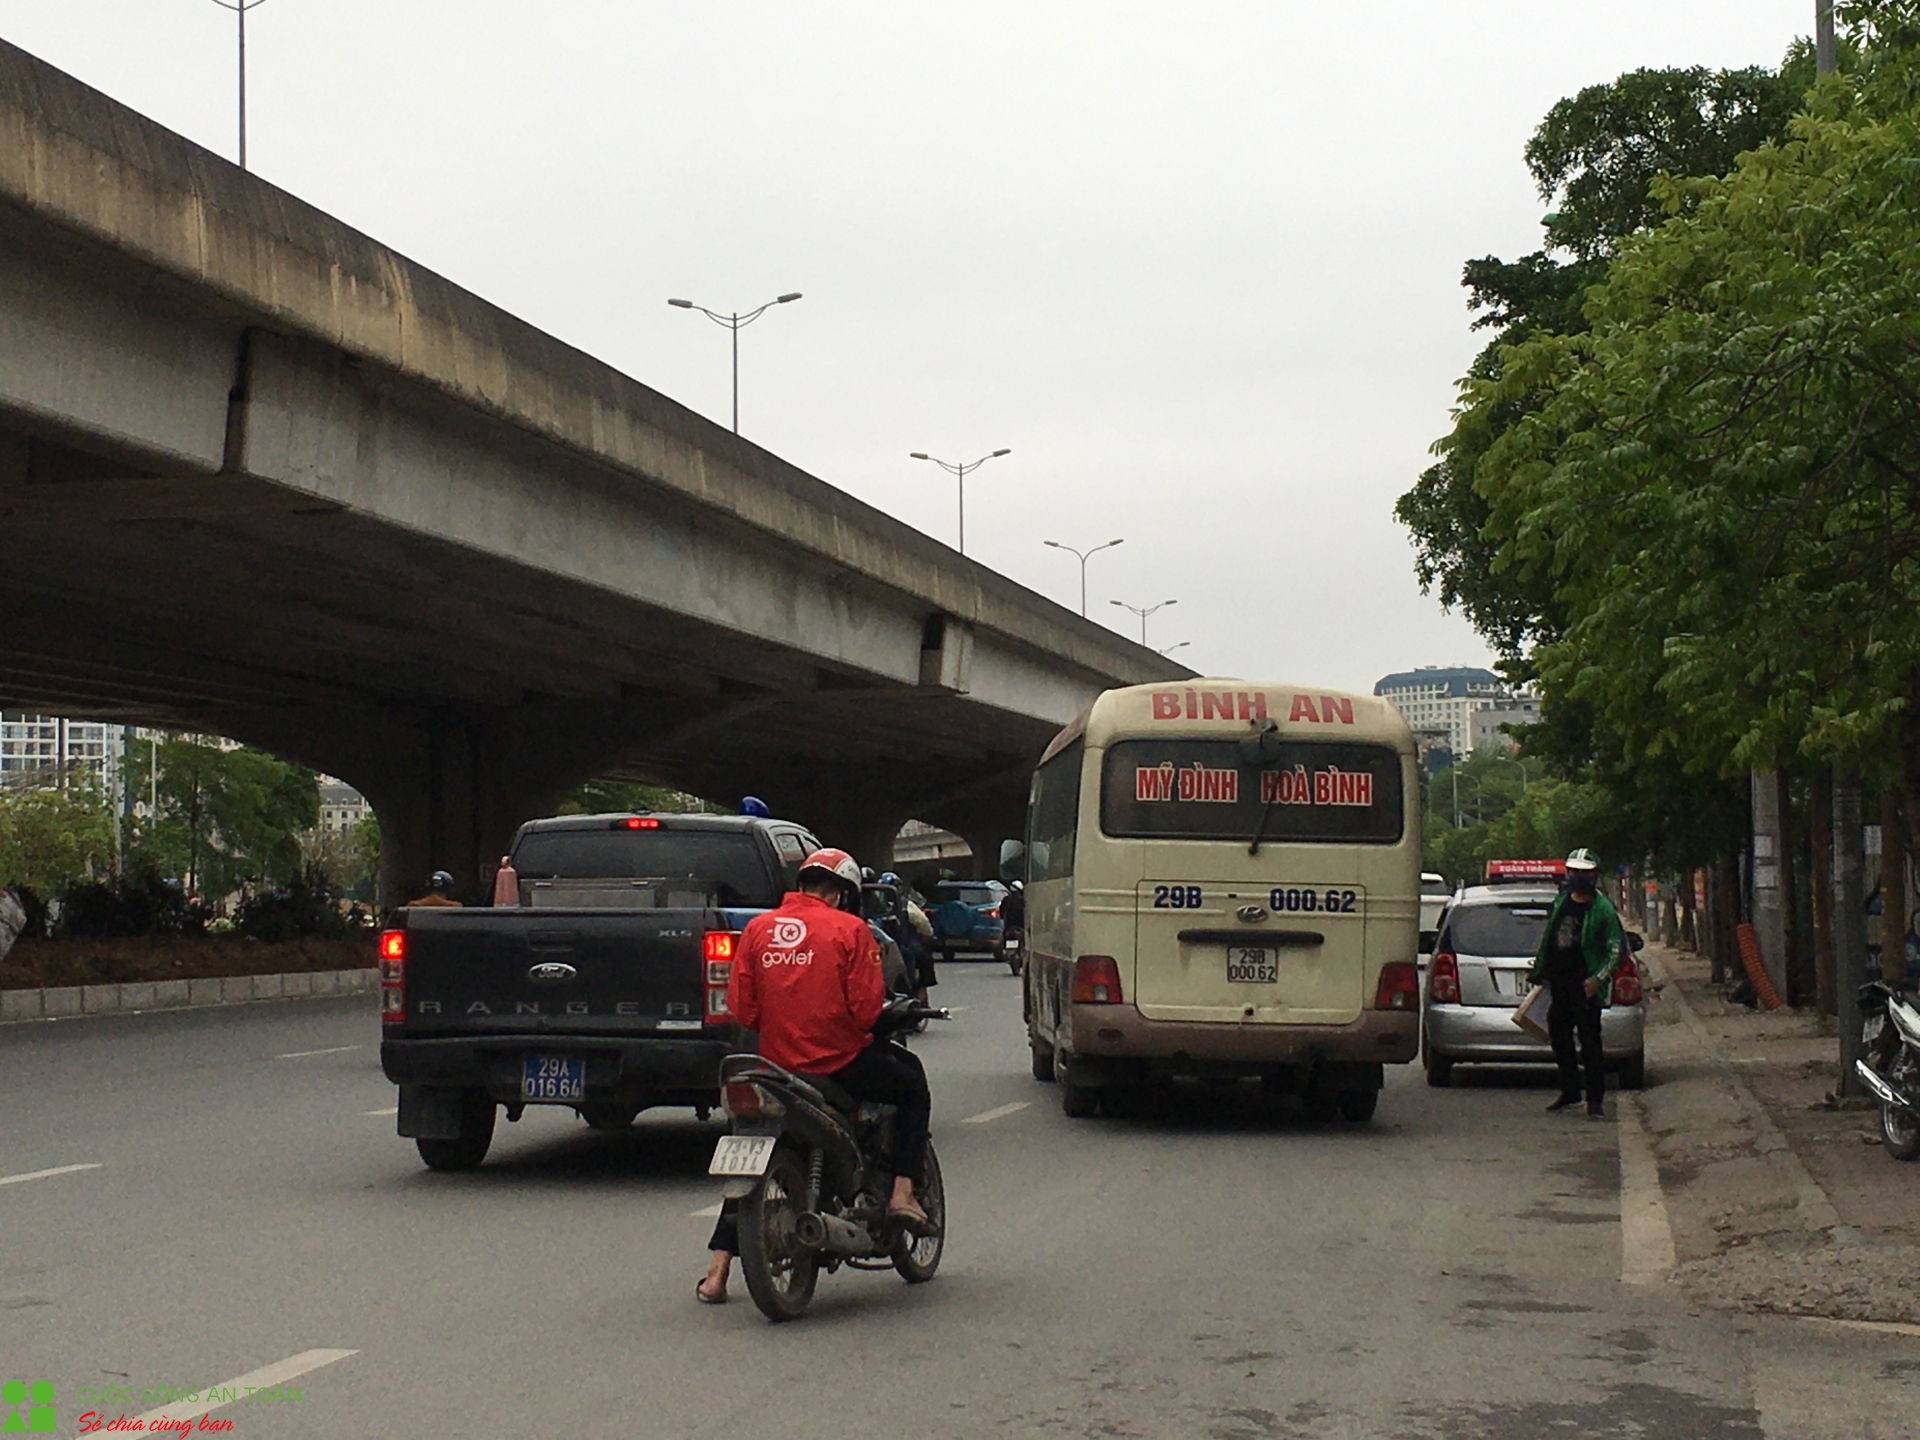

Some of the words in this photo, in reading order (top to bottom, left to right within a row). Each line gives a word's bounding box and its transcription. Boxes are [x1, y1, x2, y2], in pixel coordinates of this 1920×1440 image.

[1152, 688, 1267, 720] BÌNH
[1288, 694, 1354, 724] AN
[1136, 761, 1175, 802] MỸ
[1178, 761, 1238, 804] ĐÌNH
[1314, 764, 1373, 807] BÌNH
[1154, 885, 1202, 909] 29B
[1269, 888, 1357, 913] 000.62
[1239, 949, 1266, 965] 29B
[419, 1001, 690, 1015] RANGER
[538, 1057, 570, 1077] 29A
